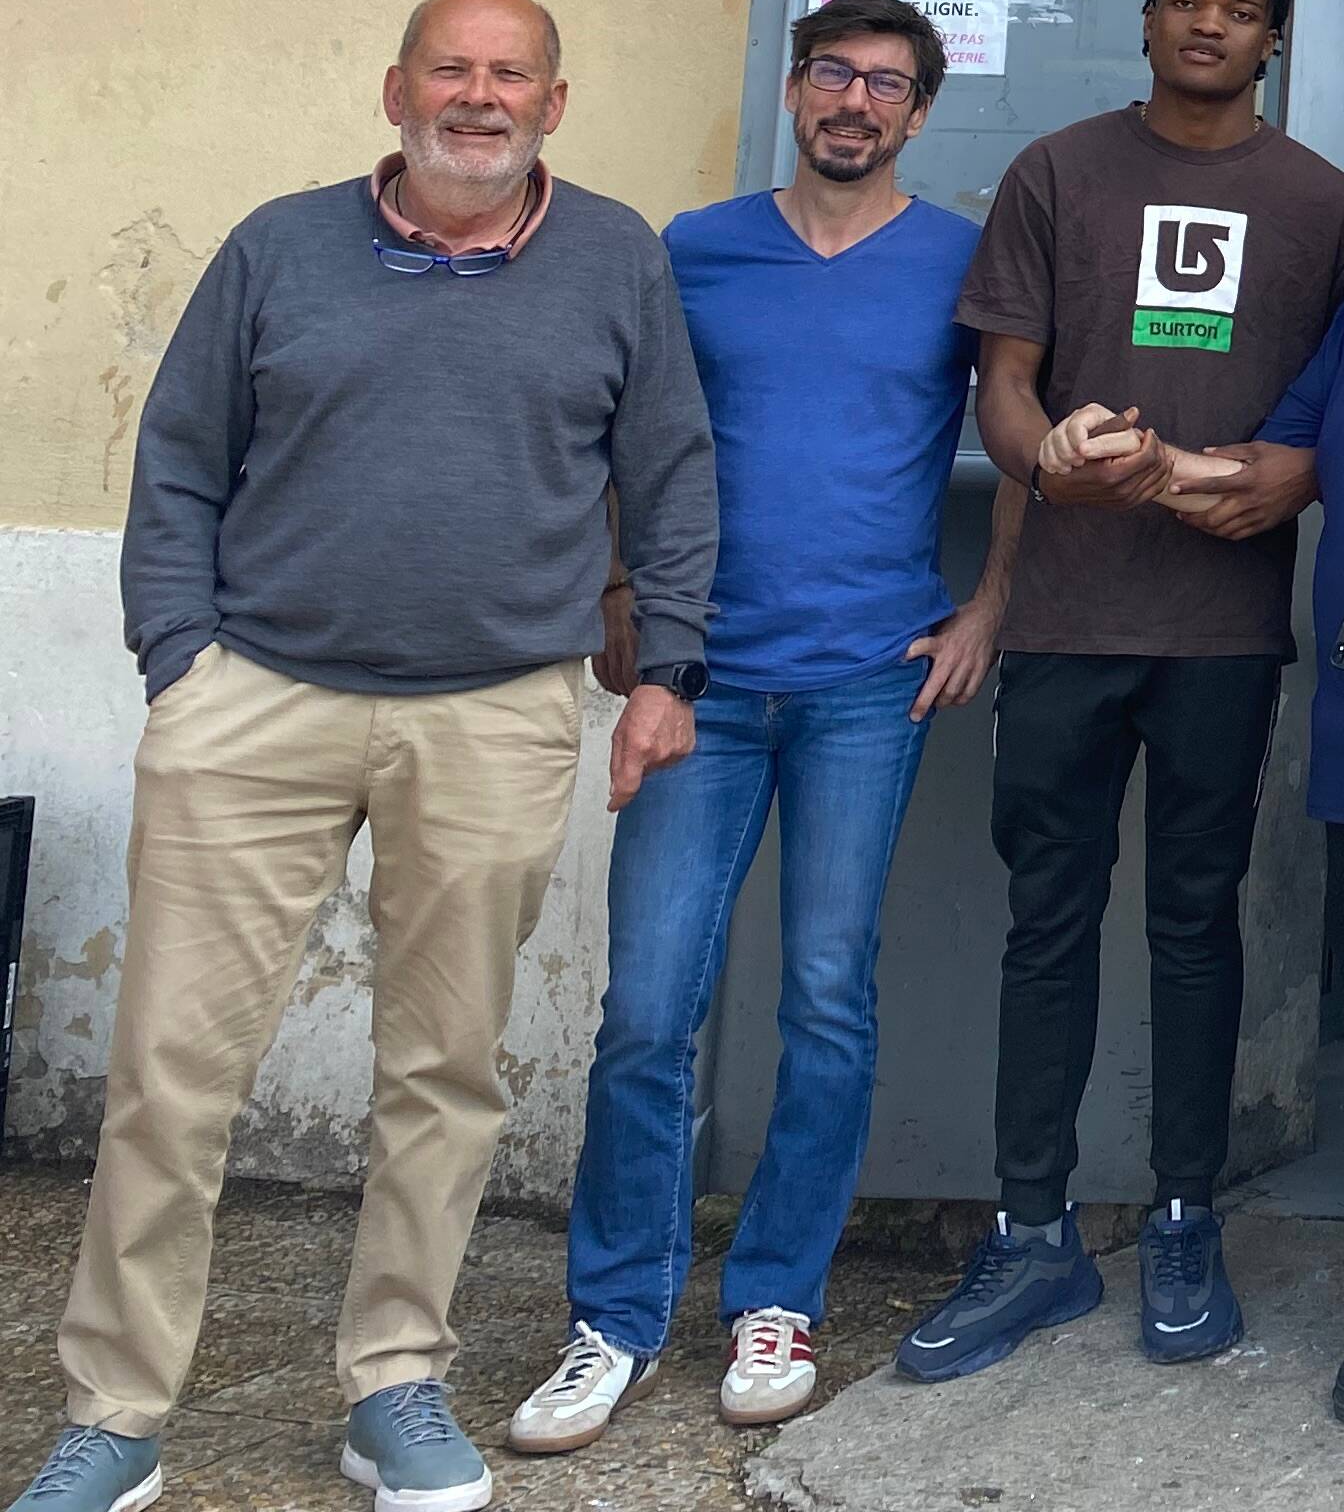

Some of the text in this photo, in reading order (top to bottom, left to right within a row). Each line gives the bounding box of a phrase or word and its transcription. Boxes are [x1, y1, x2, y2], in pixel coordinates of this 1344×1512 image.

[924, 1, 979, 17] LIGNE.
[959, 33, 985, 45] PAS
[1149, 322, 1218, 339] BURTON
